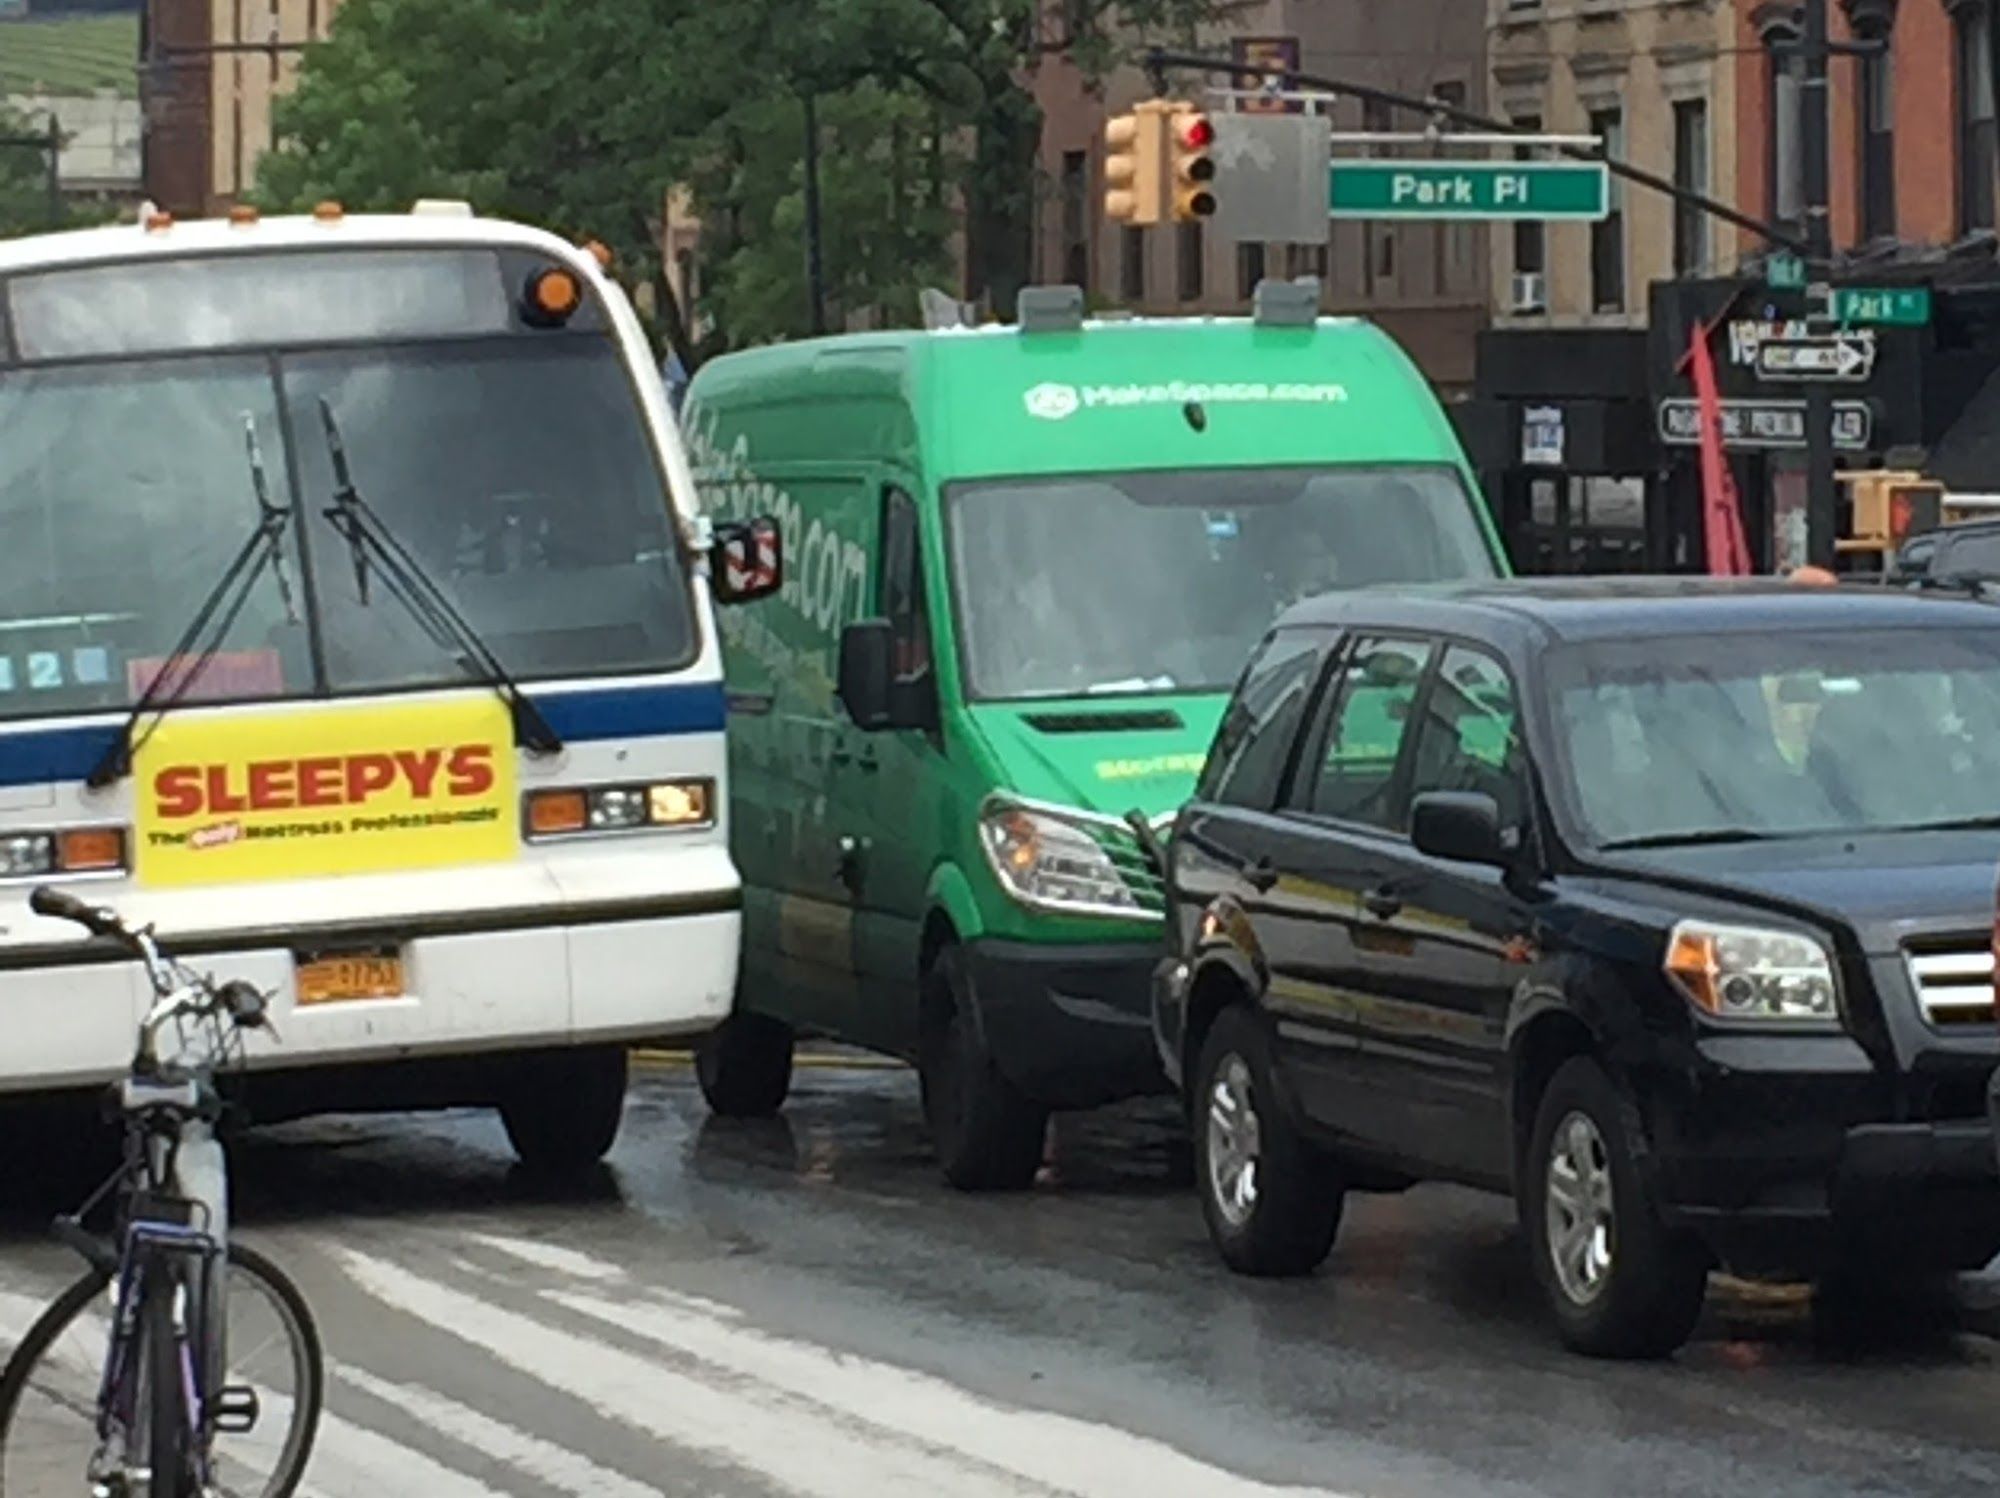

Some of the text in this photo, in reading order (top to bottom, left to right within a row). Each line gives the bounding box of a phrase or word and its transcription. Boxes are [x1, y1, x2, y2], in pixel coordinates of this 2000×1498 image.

[1391, 174, 1528, 205] Park Pl
[1845, 291, 1894, 319] Park
[1081, 381, 1347, 407] MakeSpace.com
[148, 831, 186, 846] The
[245, 821, 344, 841] Mattress
[350, 807, 499, 831] Professionals
